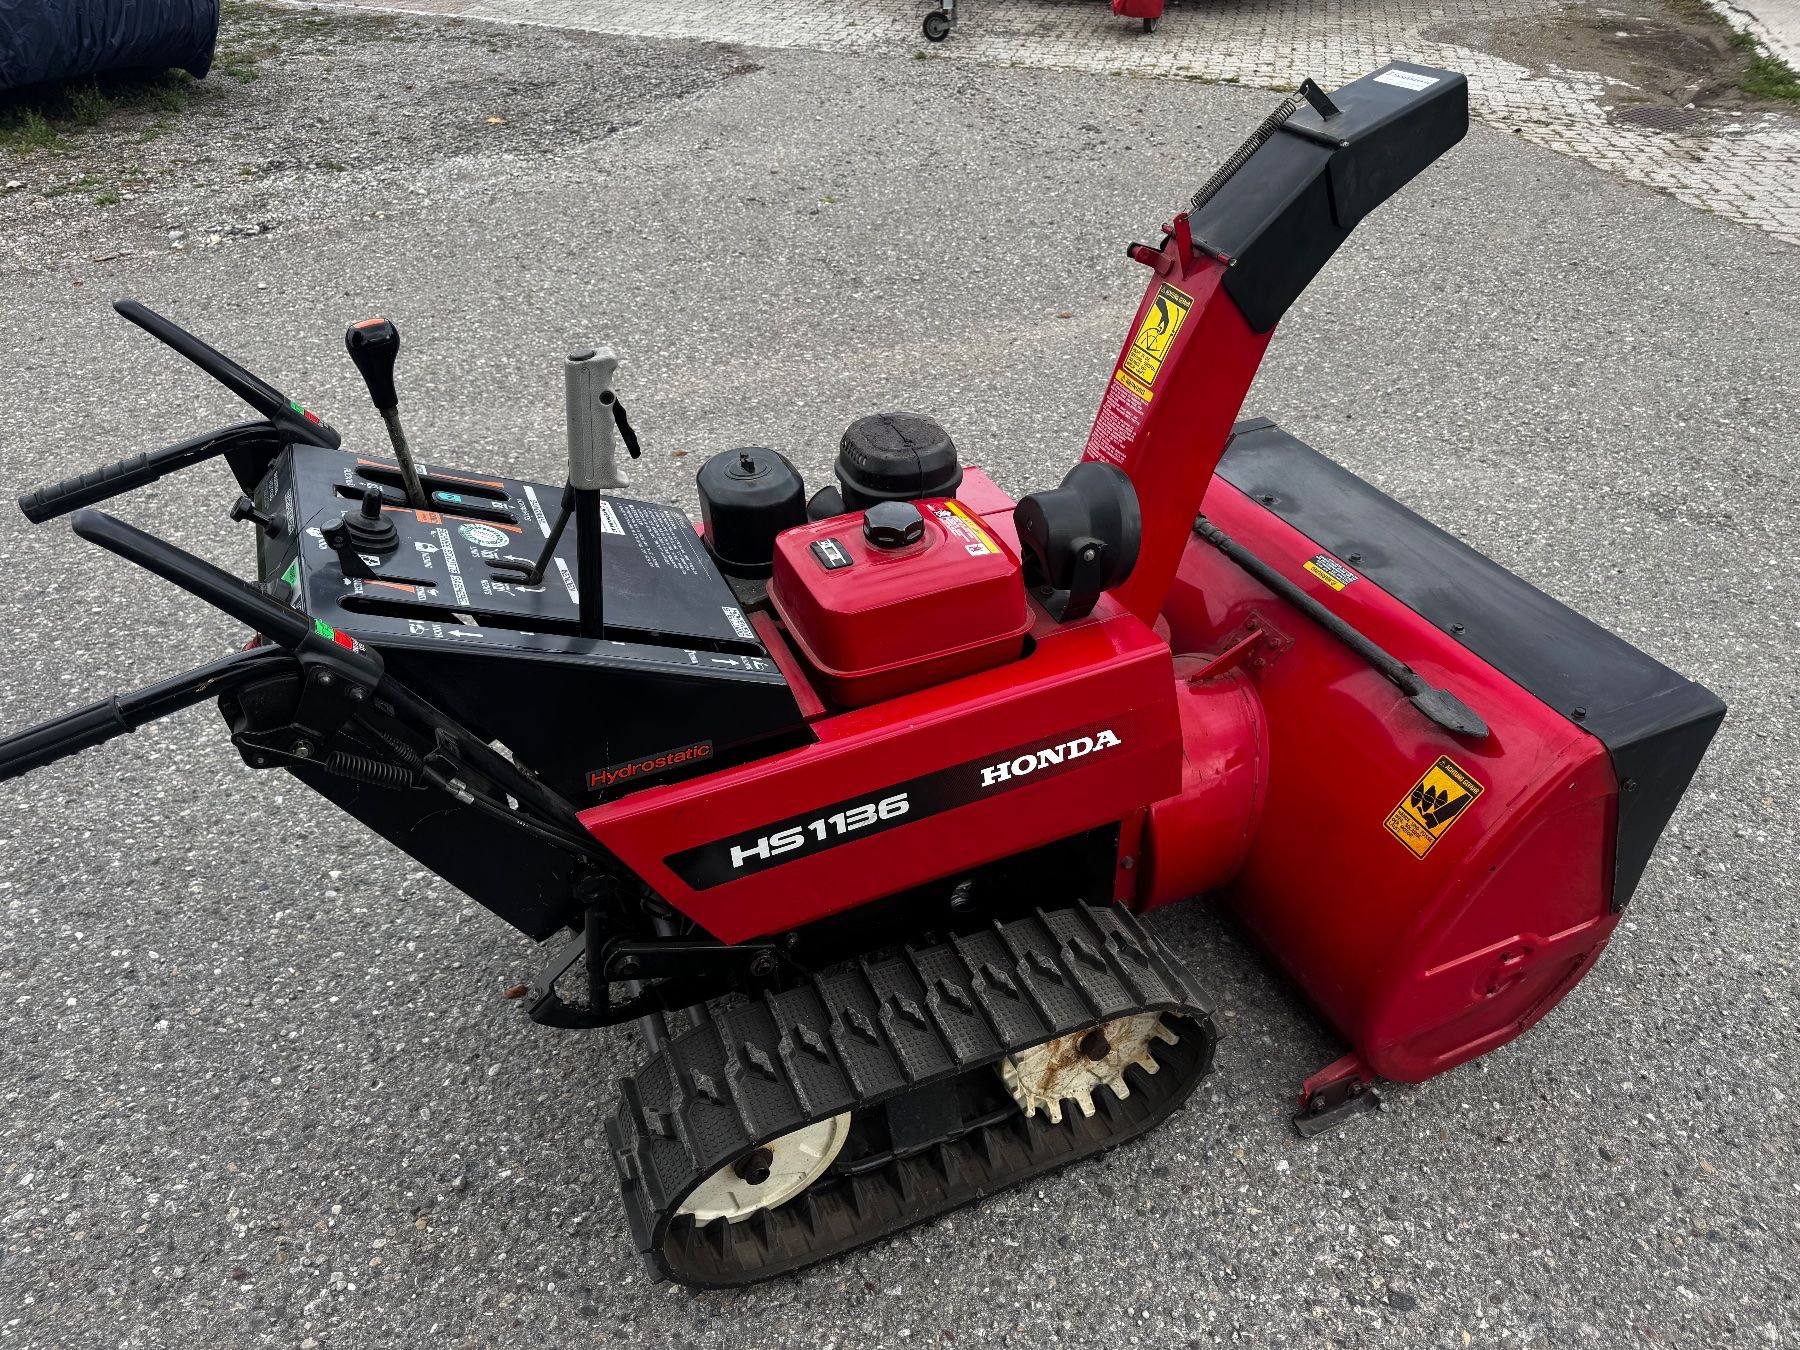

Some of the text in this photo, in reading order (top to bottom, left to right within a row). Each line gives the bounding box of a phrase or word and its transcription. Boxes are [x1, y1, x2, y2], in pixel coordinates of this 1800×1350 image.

[591, 744, 710, 787] Hydrostatic
[981, 729, 1121, 787] HONDA
[1445, 764, 1480, 795] ACHTUNG GEFAHR
[730, 793, 909, 868] HS1136
